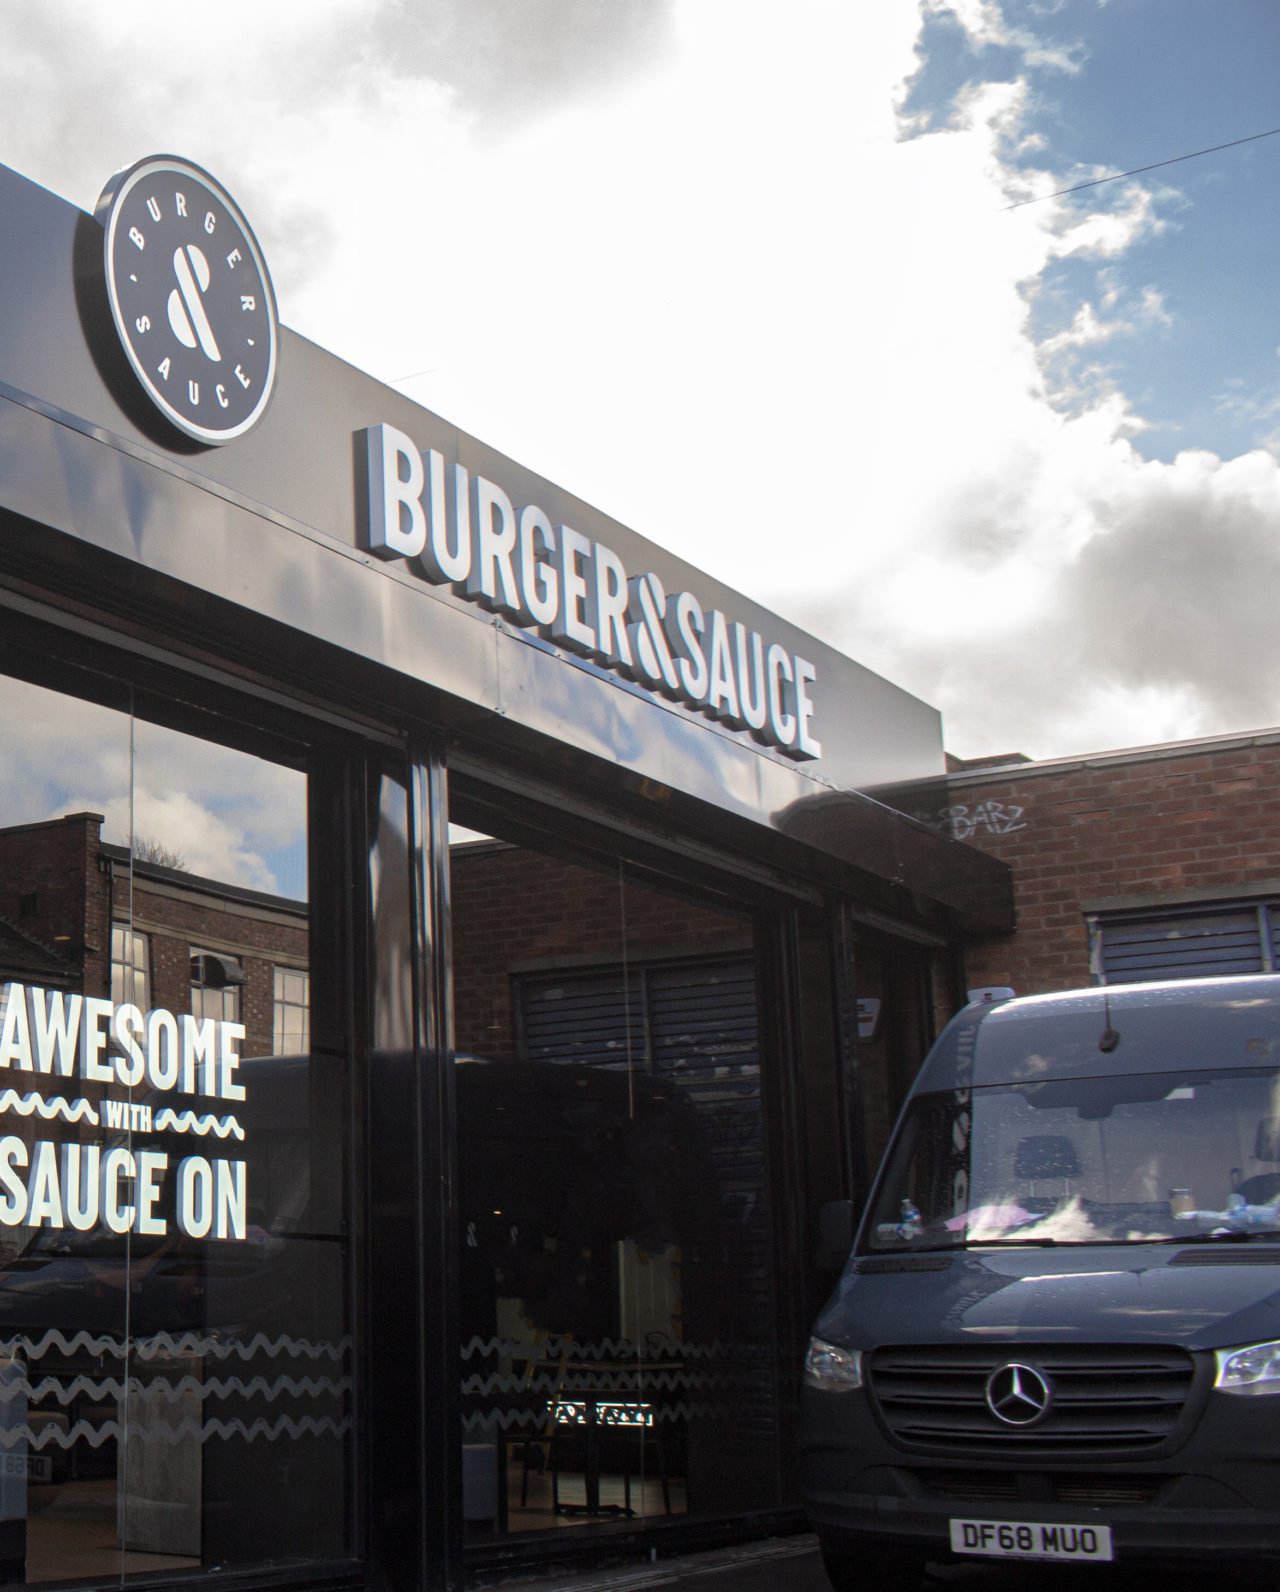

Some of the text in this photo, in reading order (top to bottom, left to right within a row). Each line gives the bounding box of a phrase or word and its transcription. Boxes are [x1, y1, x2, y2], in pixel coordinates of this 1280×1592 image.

[128, 192, 256, 311] BURGER
[135, 314, 252, 409] SAUCE
[100, 1099, 152, 1133] WITH
[177, 1155, 247, 1240] ON
[962, 1523, 1098, 1554] DF68 MUO
